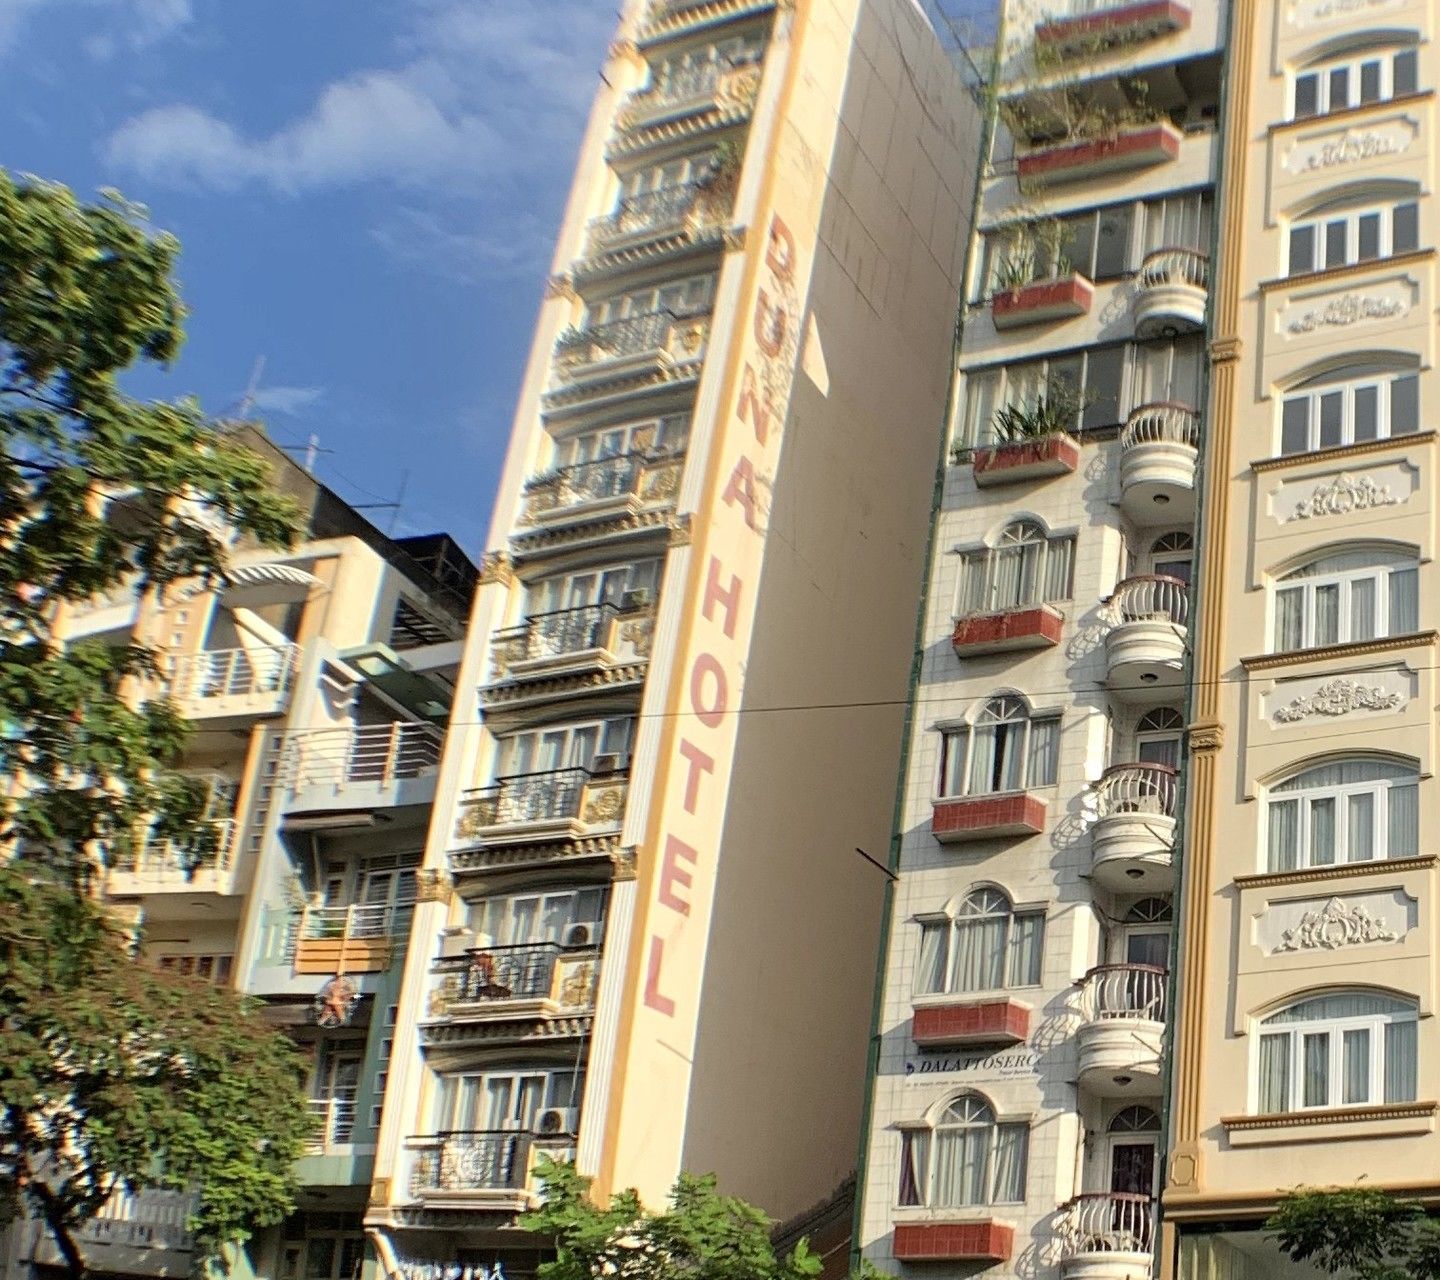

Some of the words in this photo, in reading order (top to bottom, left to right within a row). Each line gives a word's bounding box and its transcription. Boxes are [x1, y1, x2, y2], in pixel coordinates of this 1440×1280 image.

[720, 210, 797, 534] DUNA
[643, 553, 743, 1018] HOTEL
[919, 1054, 1041, 1073] DALATTOSERC
